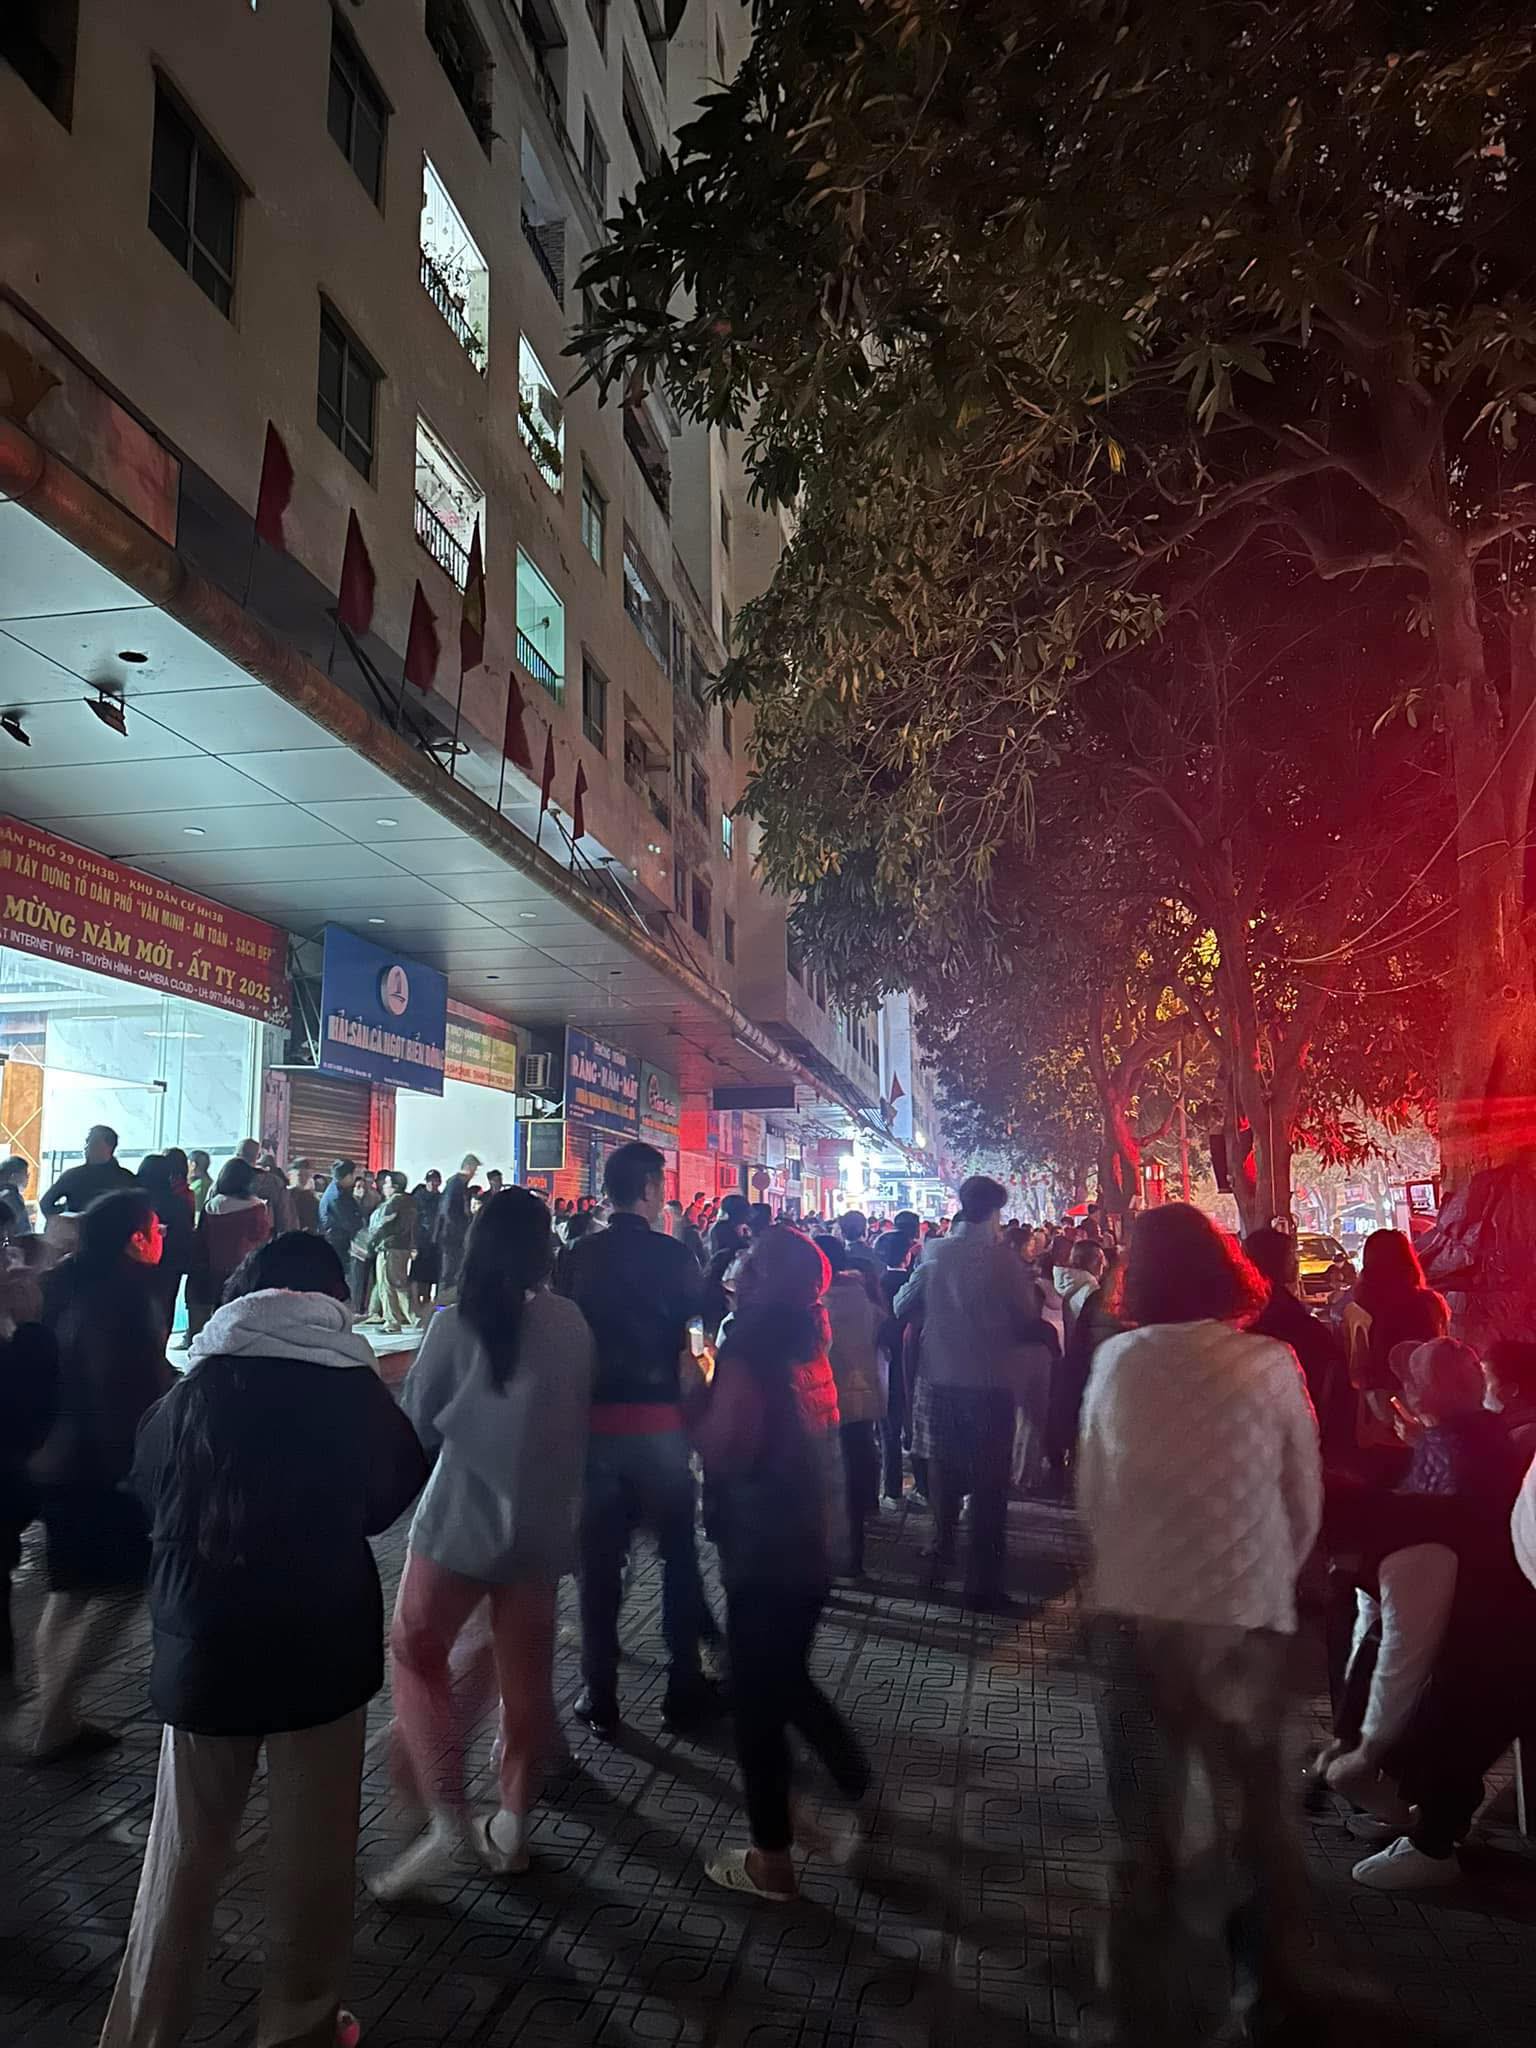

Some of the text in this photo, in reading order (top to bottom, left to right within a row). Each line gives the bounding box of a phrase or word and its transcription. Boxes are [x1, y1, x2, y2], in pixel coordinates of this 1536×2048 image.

[16, 854, 38, 879] XÂY
[41, 864, 71, 892] DỰNG
[75, 872, 88, 897] TỔ
[90, 881, 111, 905] DÂN
[114, 890, 133, 914] PHỐ
[162, 908, 185, 932] MINH
[193, 922, 205, 940] AN
[208, 926, 228, 948] TOÀN
[236, 937, 256, 957] SẠCH
[28, 838, 56, 857] PHỐ
[59, 852, 74, 865] 29
[77, 858, 119, 883] (HH3B)
[128, 879, 153, 895] KHU
[156, 888, 178, 905] DÂN
[181, 900, 195, 912] CƯ
[197, 906, 224, 923] HH3B
[3, 894, 77, 938] MỪNG
[81, 920, 131, 957] NĂM
[135, 938, 175, 970] MỚI
[187, 948, 212, 981] ẤT
[215, 965, 237, 995] TỴ
[239, 977, 272, 1004] 2025
[10, 929, 54, 953] INTERNET
[55, 944, 74, 960] WIFI
[81, 950, 113, 971] TRUYỀN
[114, 960, 133, 976] HÌNH
[138, 969, 170, 988] CAMERA
[170, 979, 194, 994] CLOUD
[328, 1009, 348, 1043] HẢI
